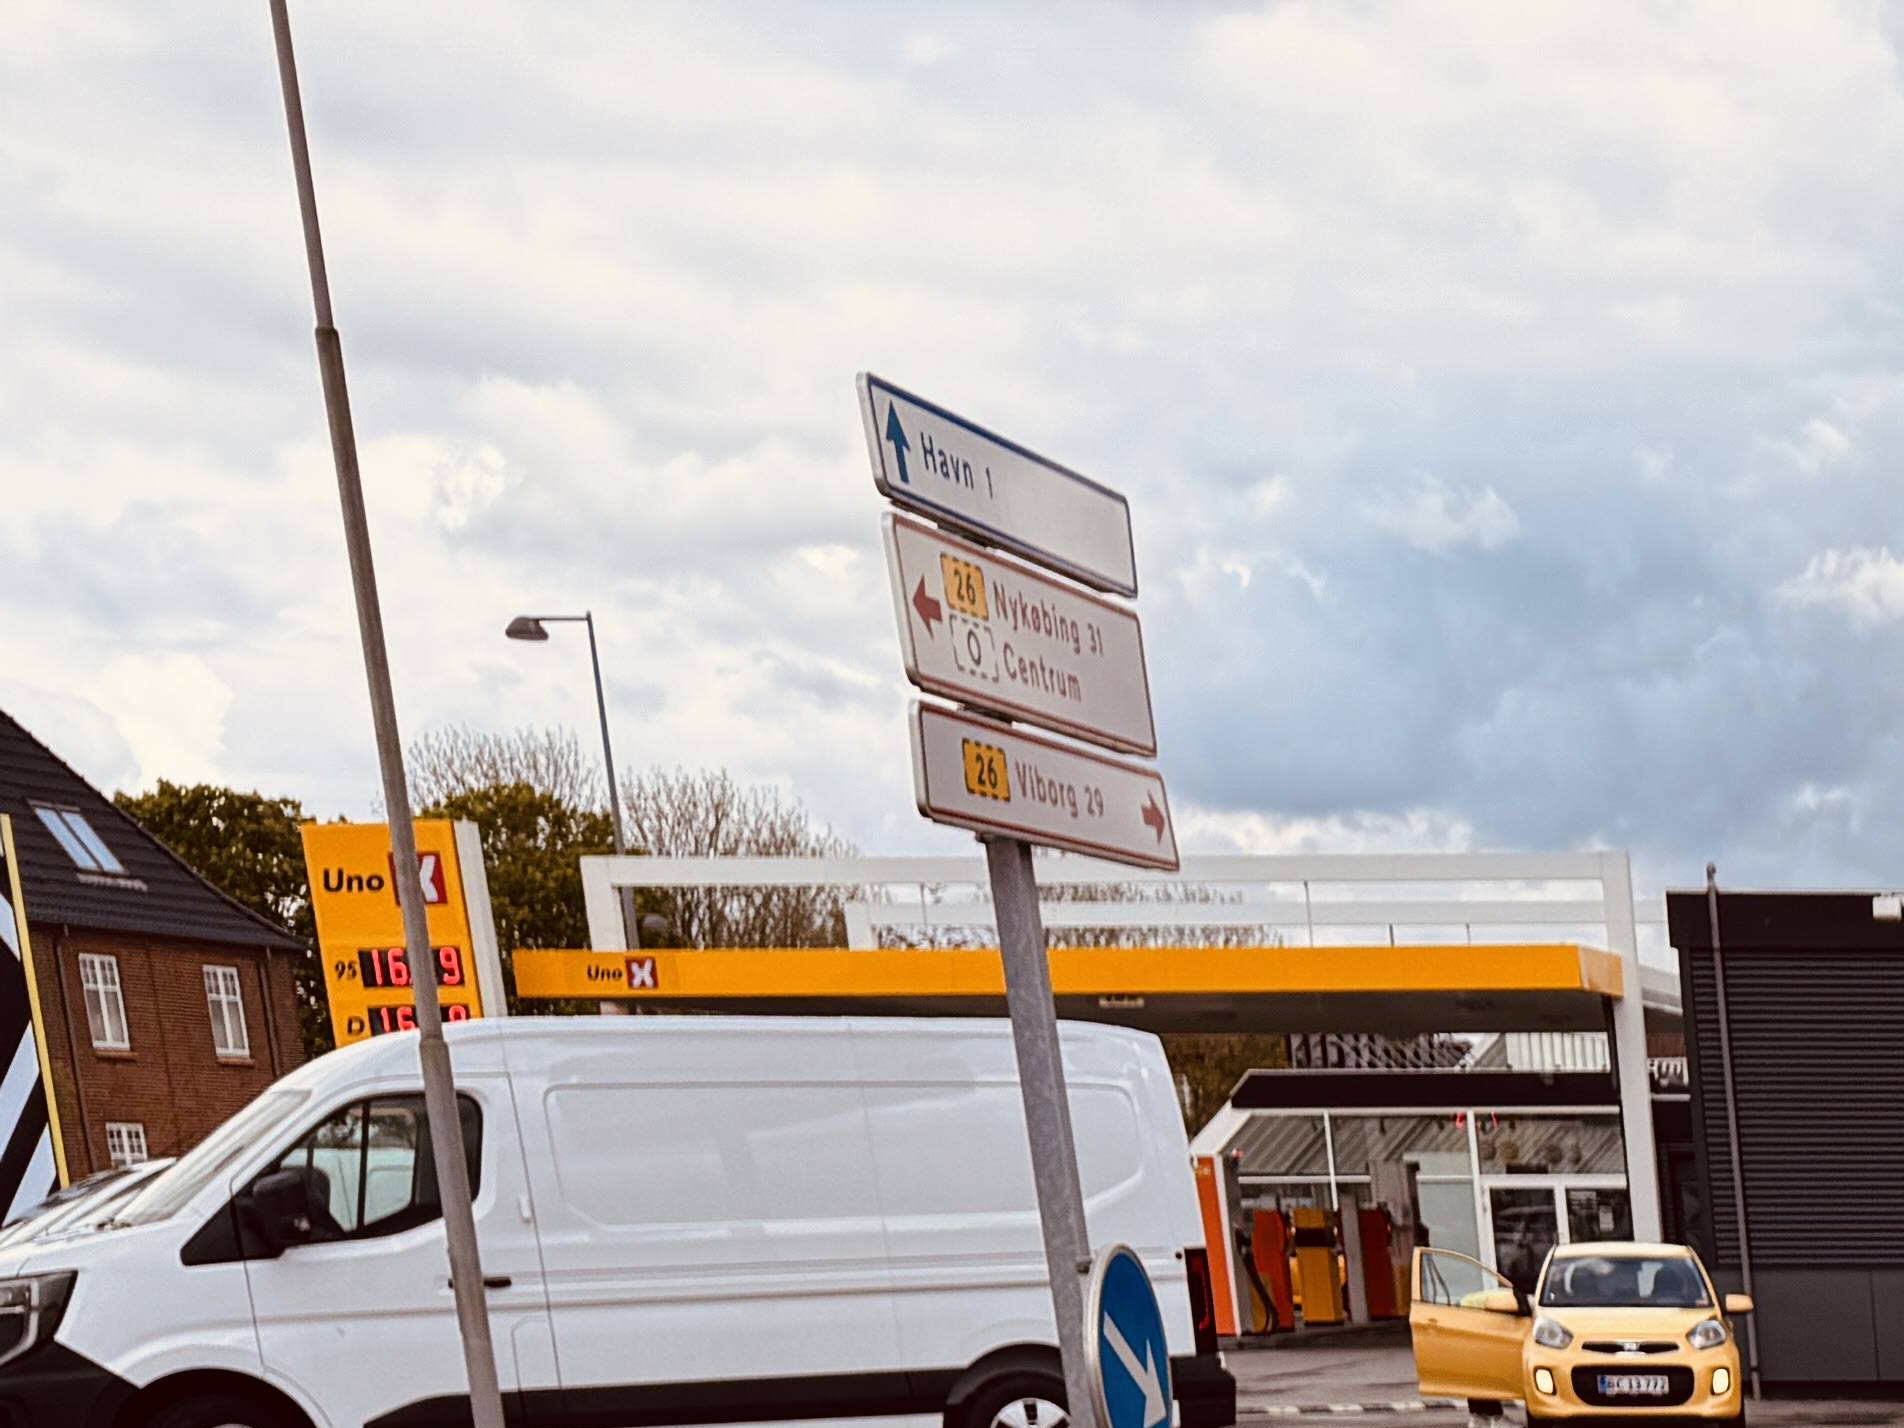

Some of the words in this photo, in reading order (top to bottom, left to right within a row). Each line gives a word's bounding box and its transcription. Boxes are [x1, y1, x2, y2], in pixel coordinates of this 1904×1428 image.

[920, 431, 974, 491] Havn
[985, 466, 994, 500] 1
[953, 568, 977, 606] 26
[993, 580, 1081, 656] Nykøbing
[1087, 622, 1104, 657] 31
[1003, 641, 1082, 703] Centrum
[975, 752, 998, 790] 26
[1014, 758, 1079, 819] Viborg
[1084, 783, 1104, 819] 29
[323, 867, 385, 892] Uno
[334, 960, 357, 980] 95
[587, 964, 623, 982] Uno
[347, 1016, 365, 1034] D
